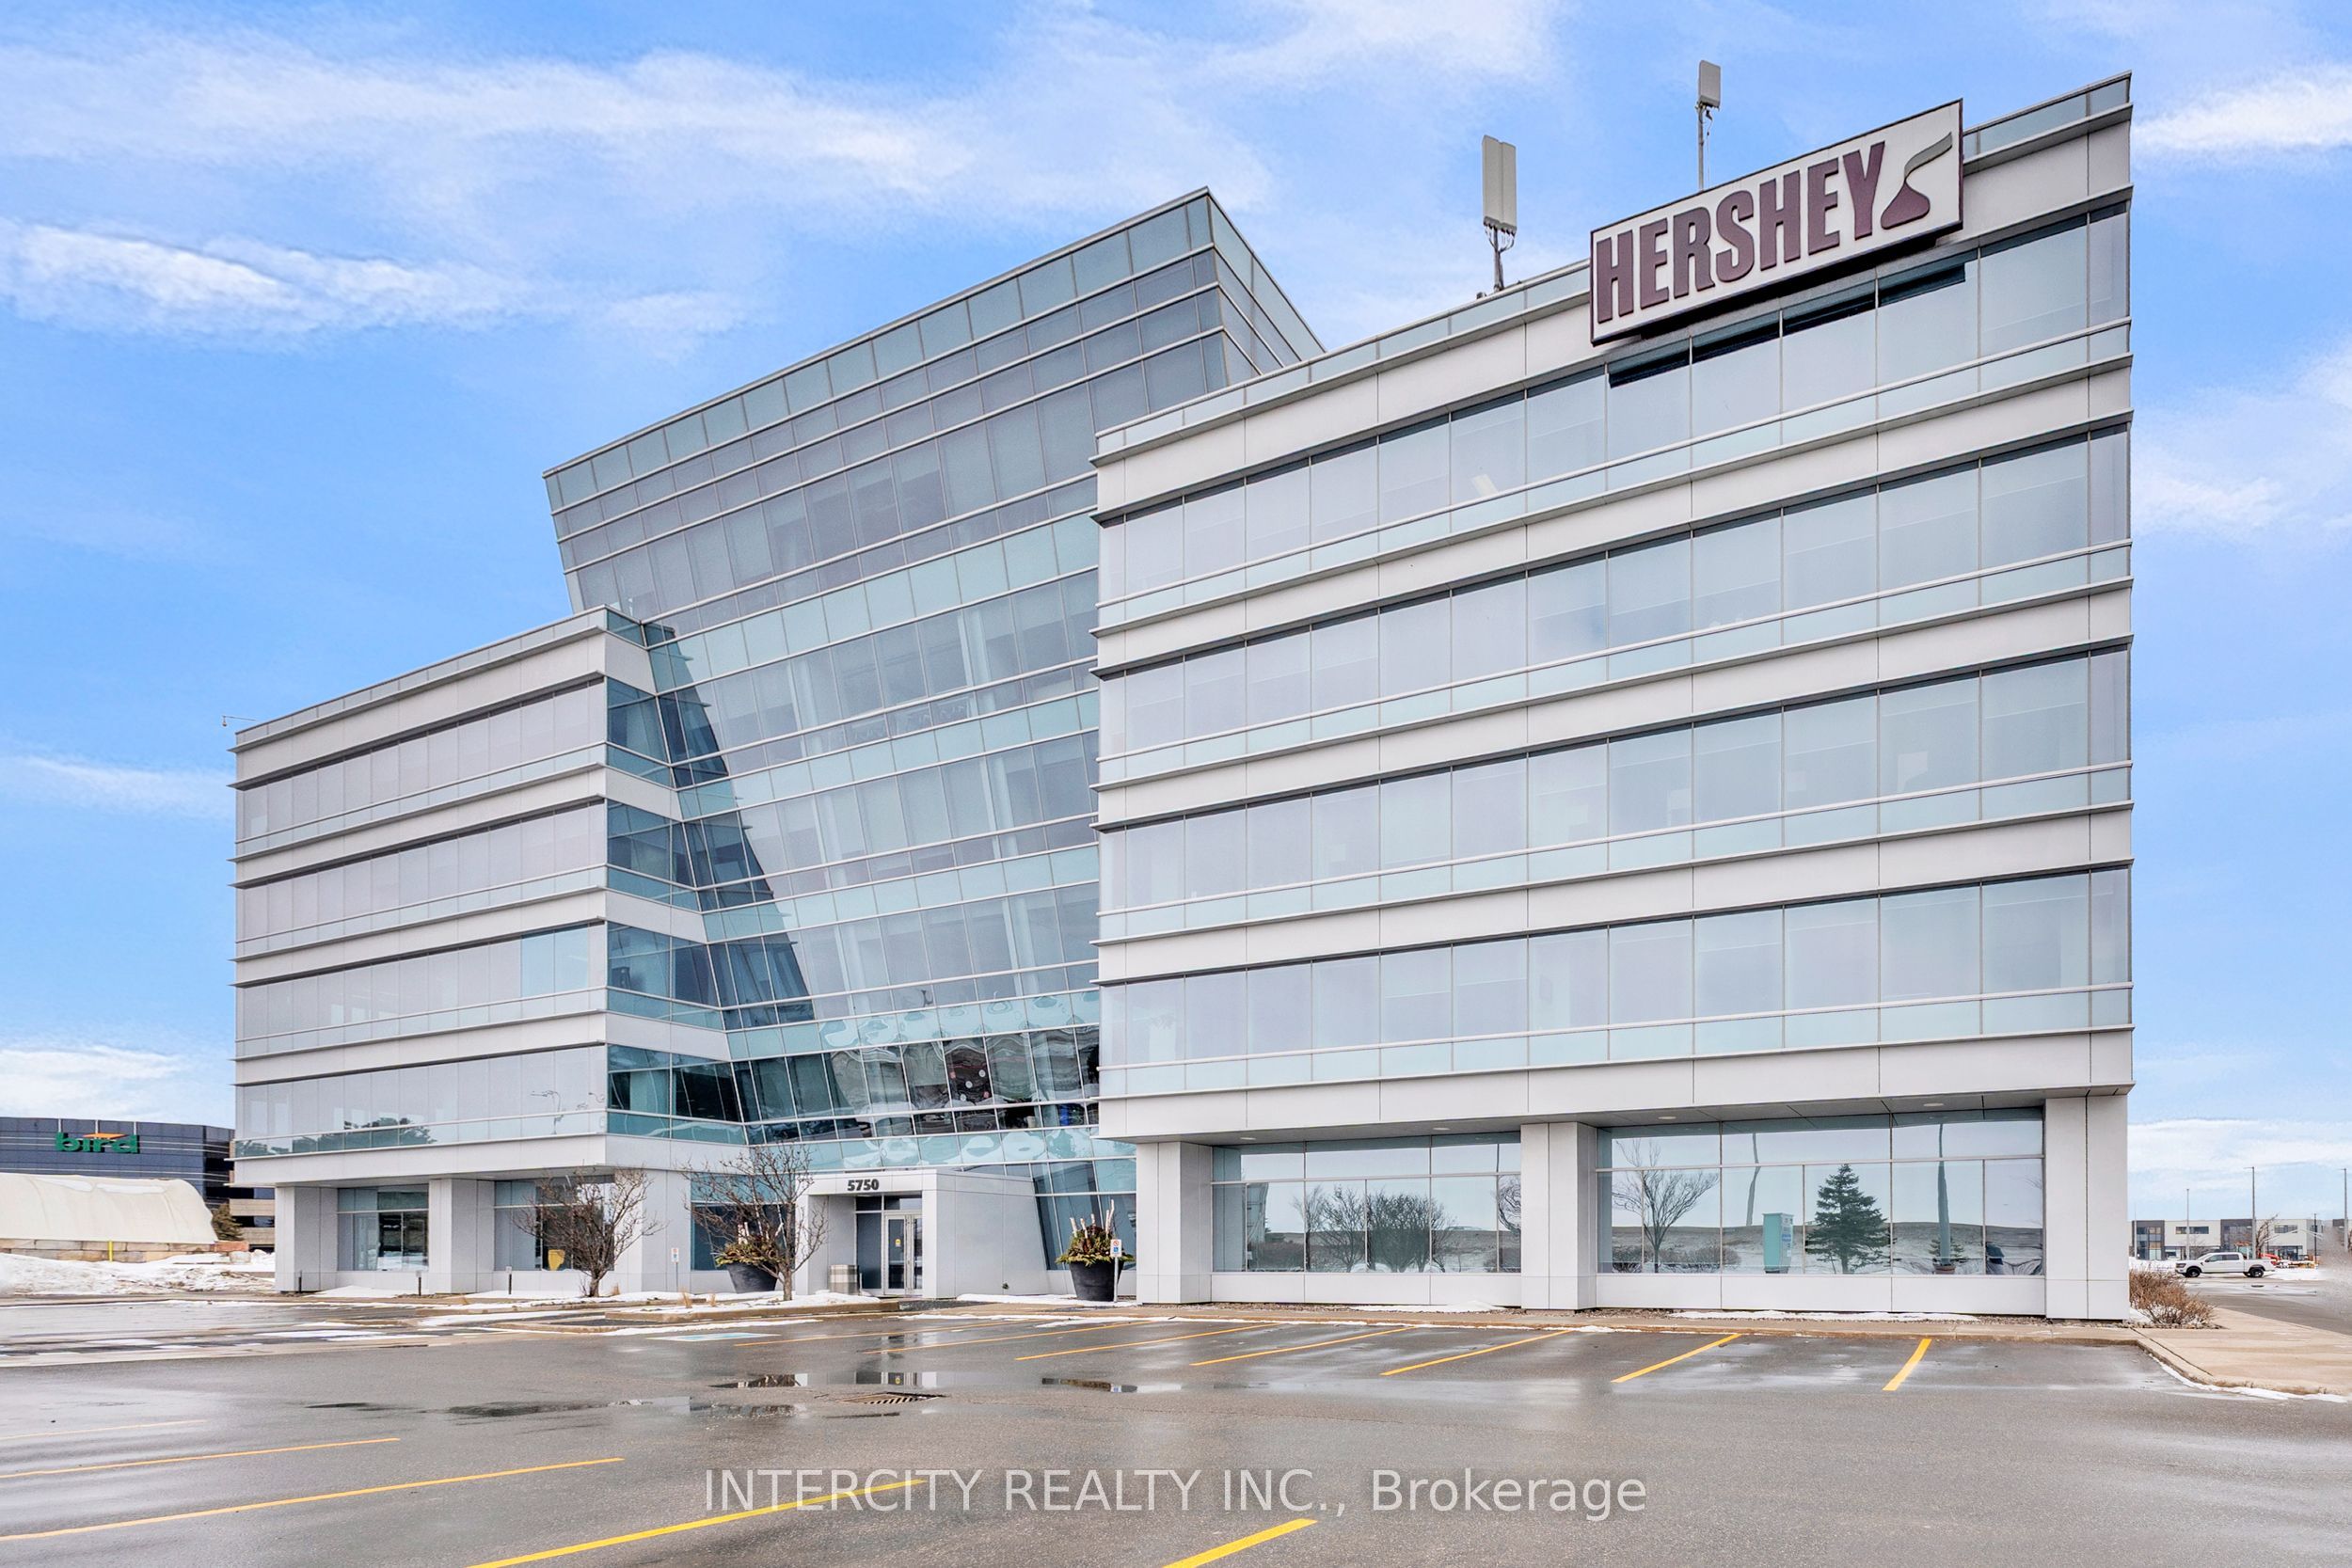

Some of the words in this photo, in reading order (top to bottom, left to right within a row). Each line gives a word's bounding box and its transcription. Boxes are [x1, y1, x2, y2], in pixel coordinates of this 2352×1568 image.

[1597, 140, 1885, 324] HERSHEY
[56, 1132, 138, 1153] bird
[847, 1179, 880, 1192] 5750
